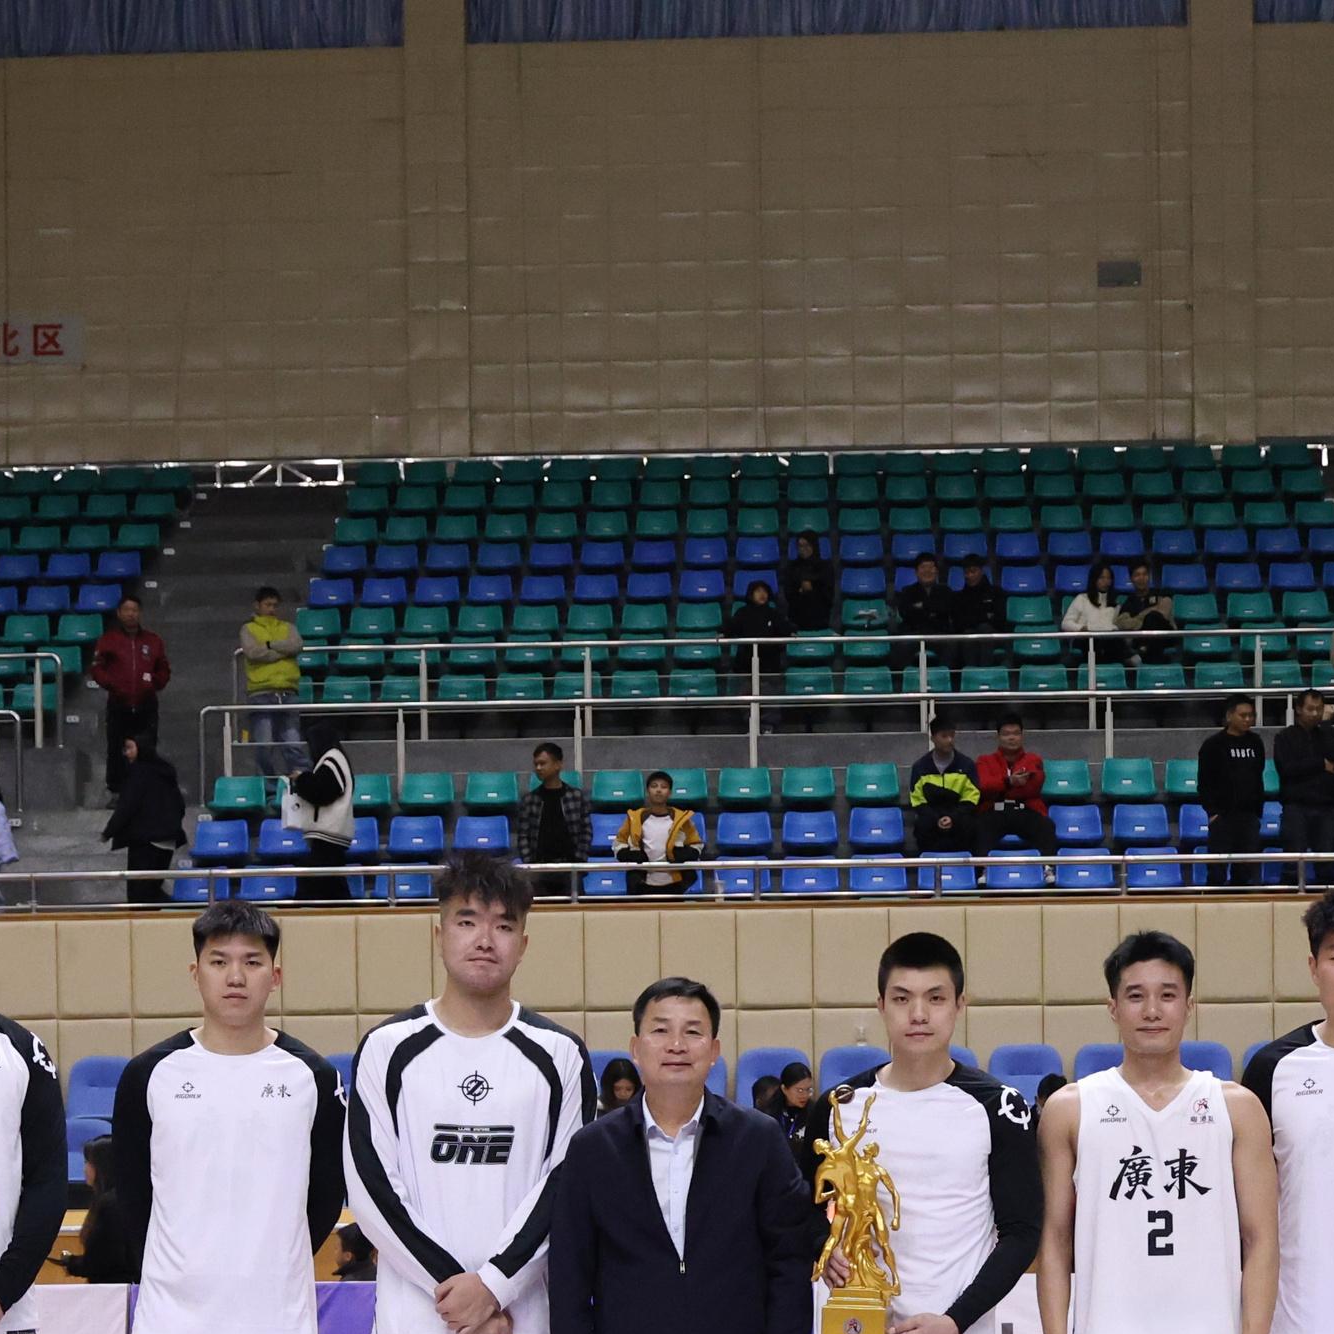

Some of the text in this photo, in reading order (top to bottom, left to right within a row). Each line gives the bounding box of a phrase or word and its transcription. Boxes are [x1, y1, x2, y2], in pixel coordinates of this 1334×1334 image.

[430, 1132, 515, 1165] ONE
[1109, 1145, 1212, 1200] 廣東
[1148, 1210, 1174, 1256] 2
